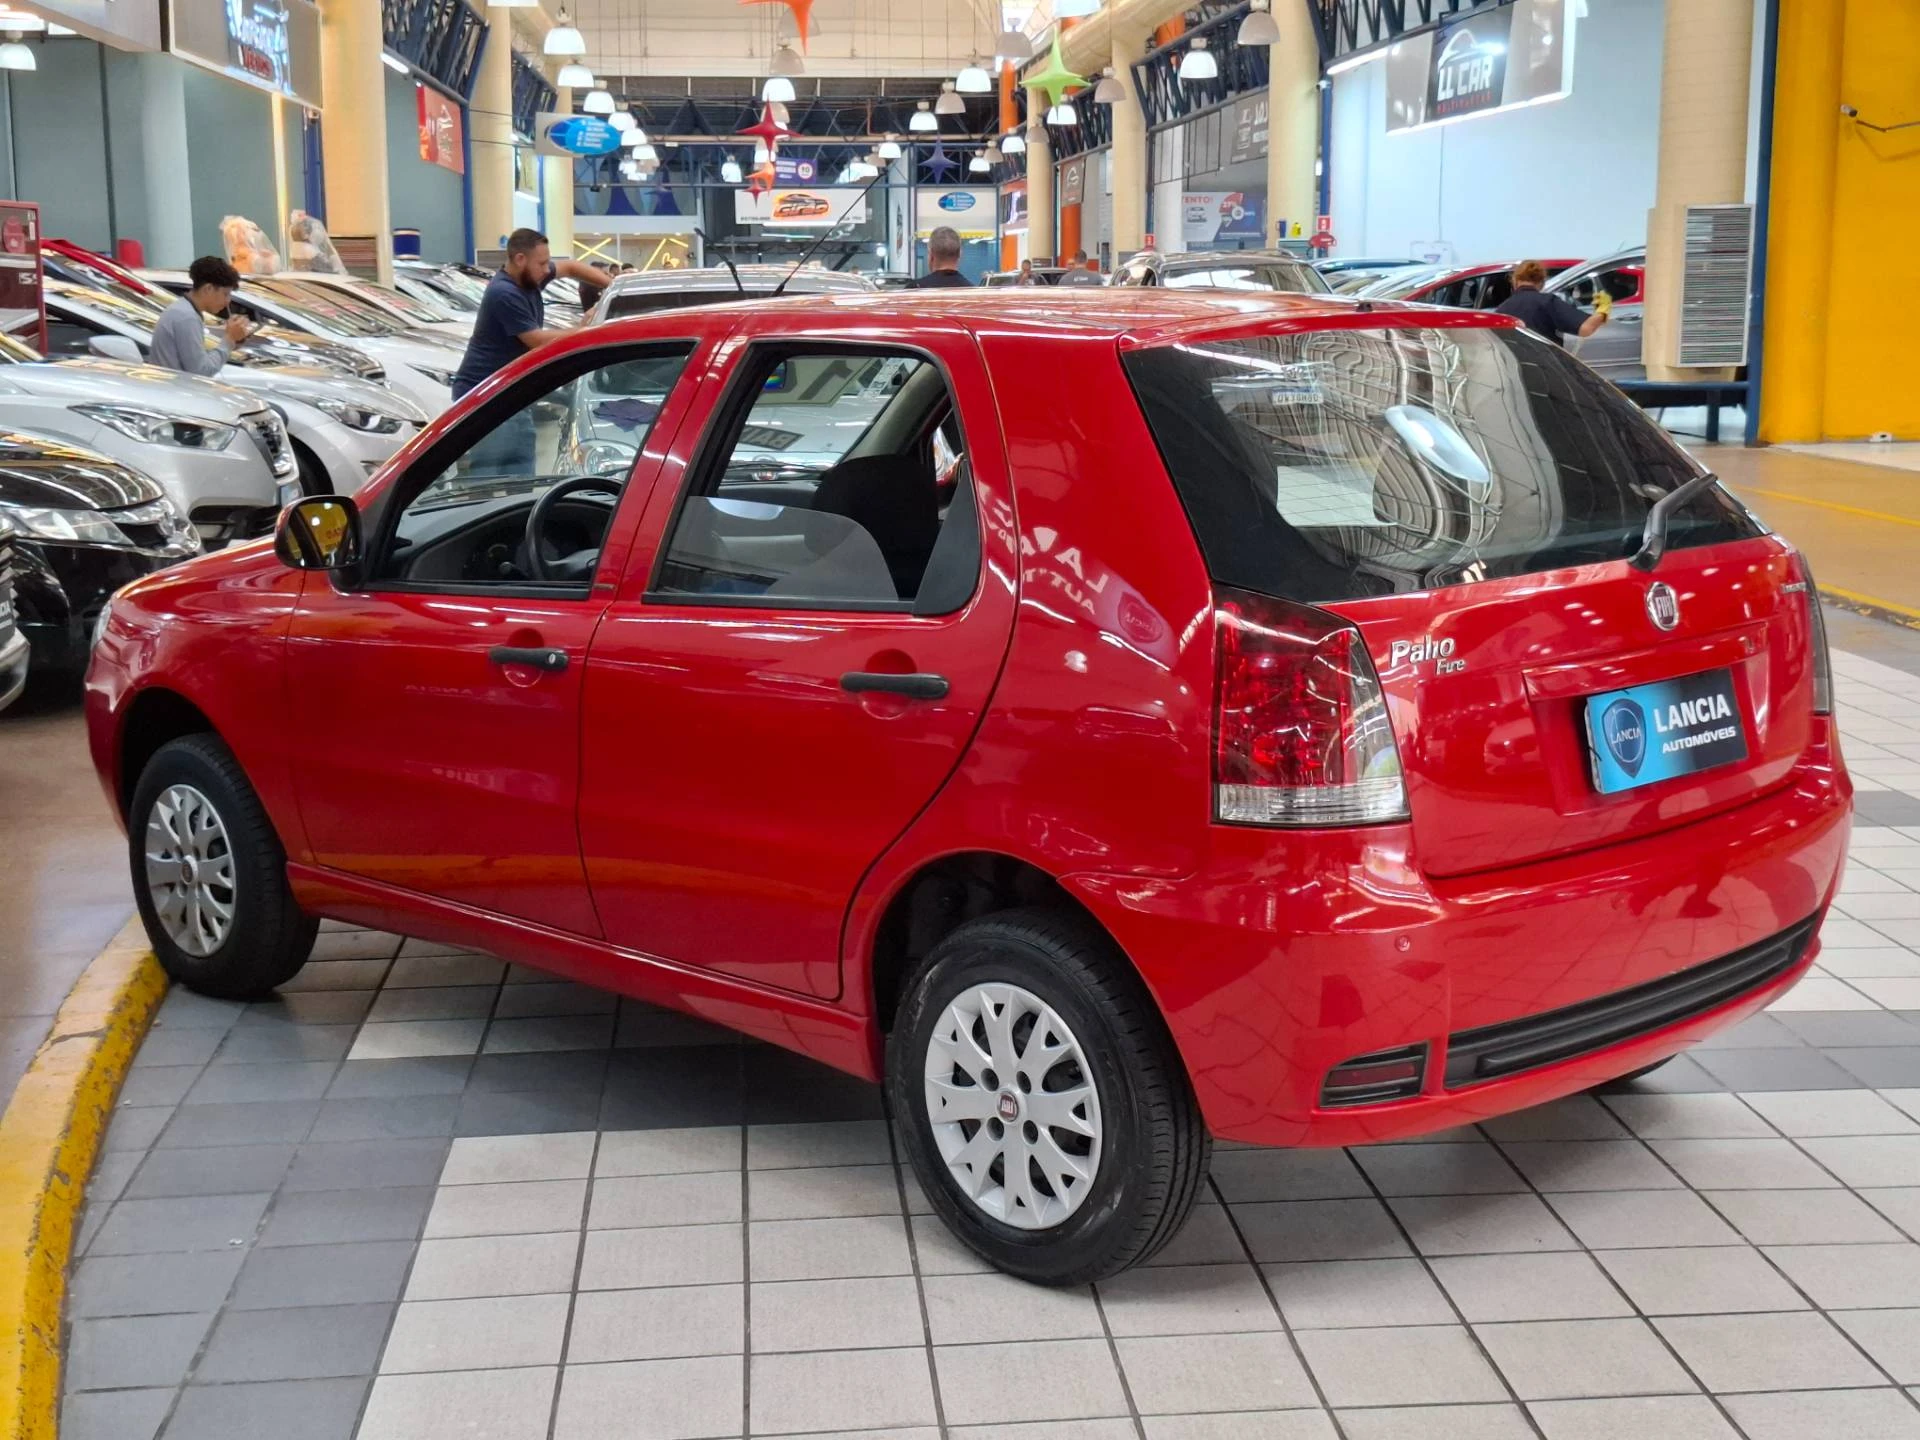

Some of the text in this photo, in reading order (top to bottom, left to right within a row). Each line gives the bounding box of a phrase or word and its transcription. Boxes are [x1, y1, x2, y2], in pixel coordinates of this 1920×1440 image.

[1457, 55, 1493, 95] CAR
[1391, 634, 1455, 668] Palio
[1436, 658, 1464, 675] Fire
[1653, 694, 1732, 733] LANCIA
[1611, 728, 1642, 745] LANCIA
[1662, 726, 1736, 754] AUTOMÓVEIS
